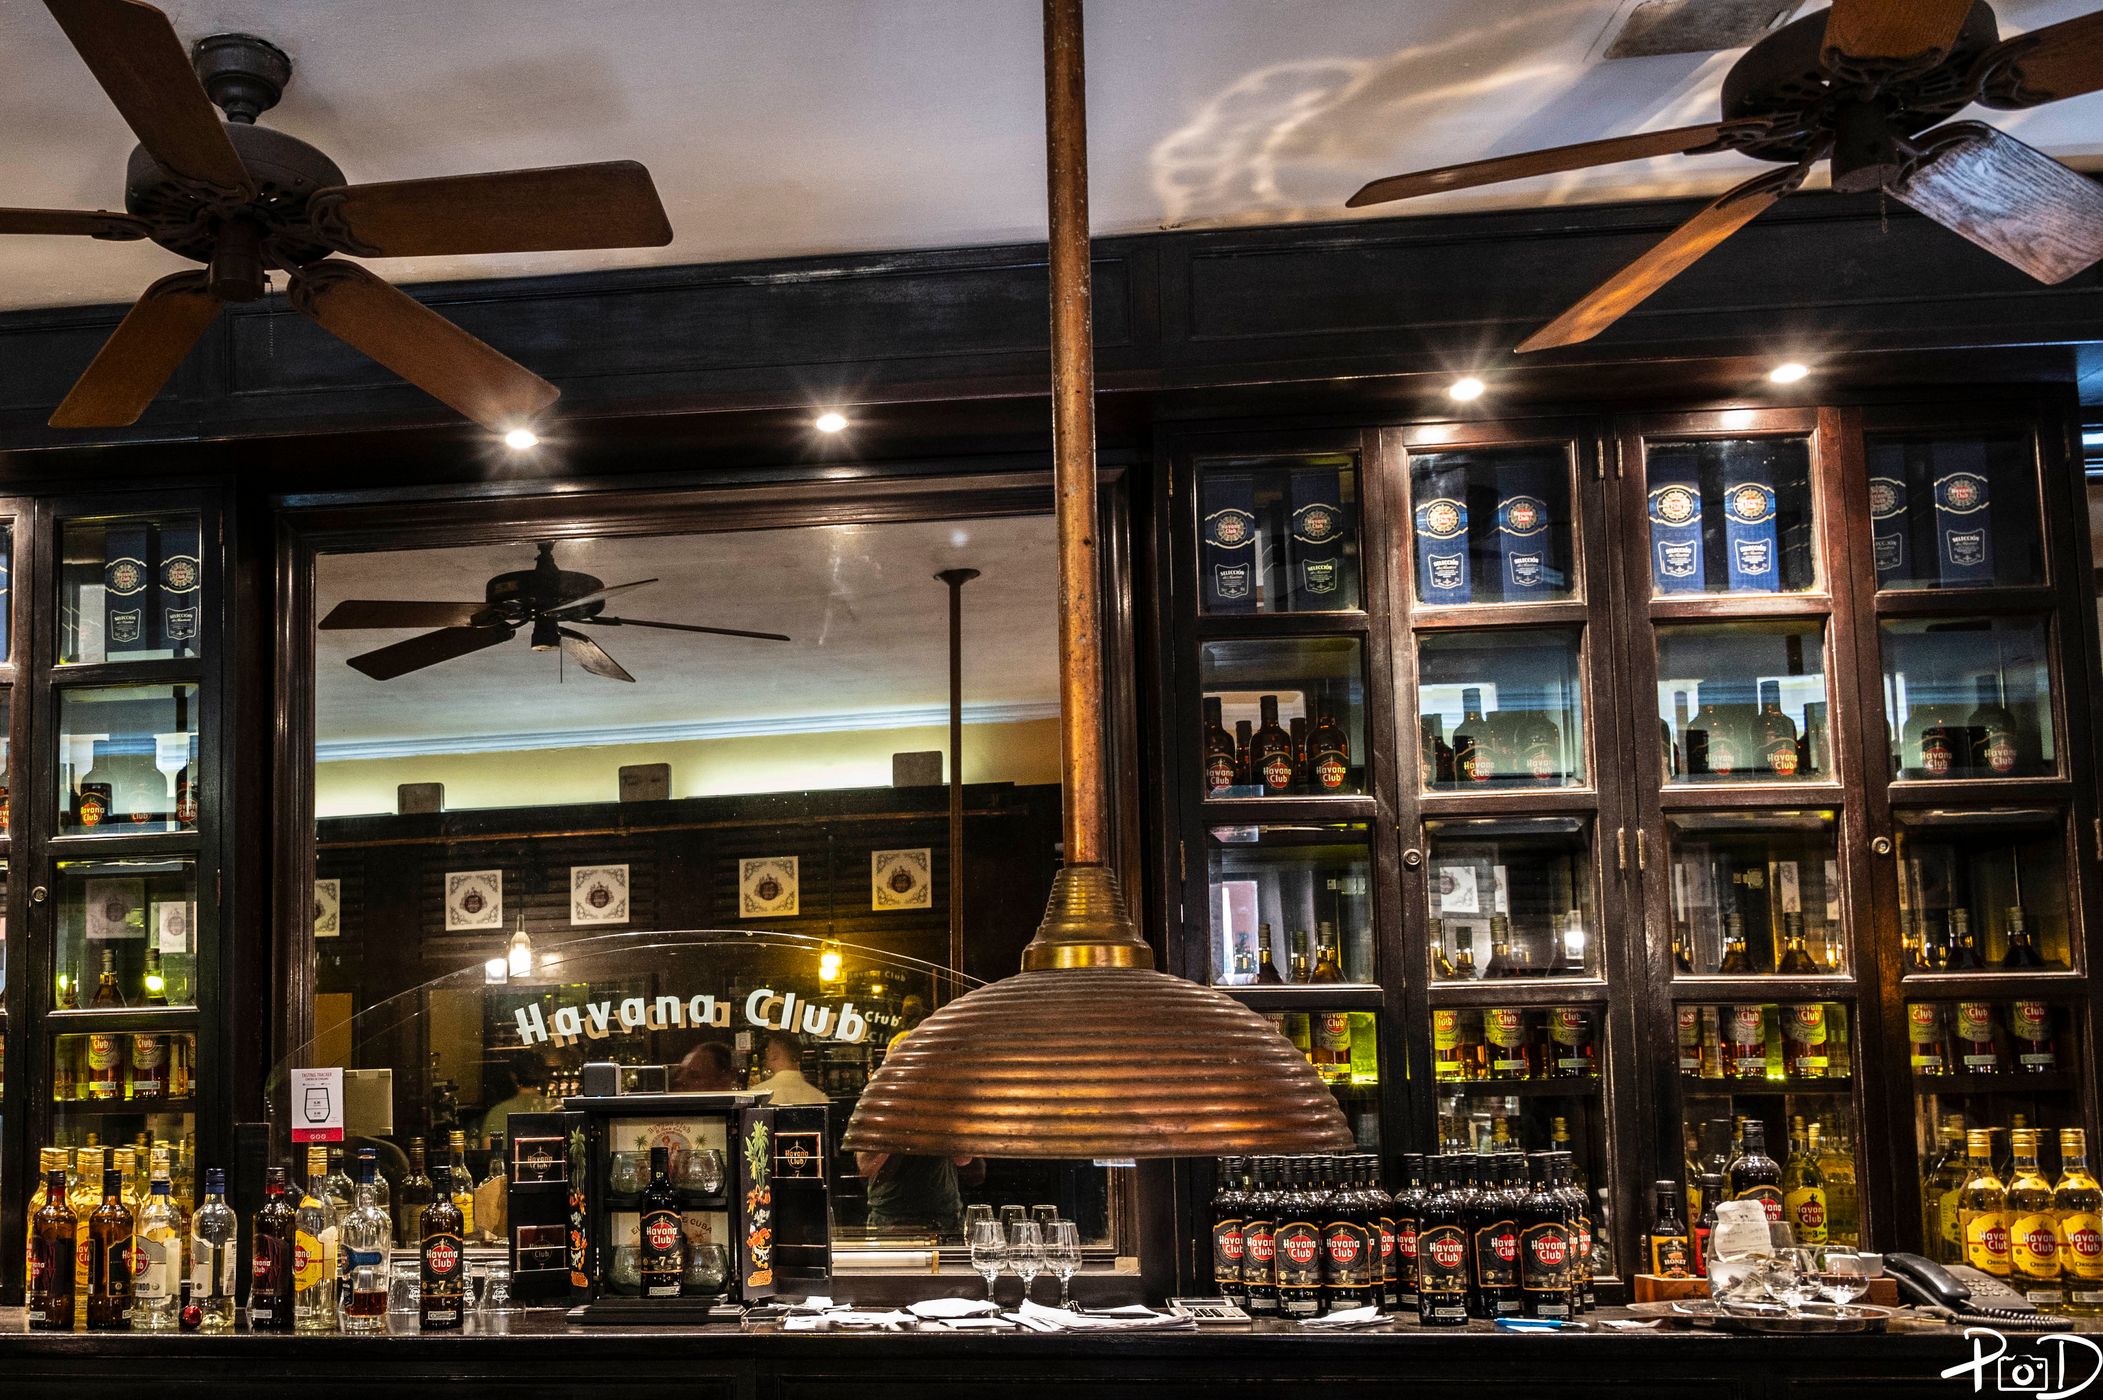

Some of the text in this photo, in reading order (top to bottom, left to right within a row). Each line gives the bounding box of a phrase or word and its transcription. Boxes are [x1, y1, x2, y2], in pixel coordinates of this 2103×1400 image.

[514, 989, 865, 1046] Havana Club
[93, 1040, 109, 1048] Club
[137, 1039, 154, 1048] Club
[784, 1149, 809, 1158] Havana
[790, 1157, 805, 1165] Club
[1763, 1204, 1782, 1213] vana
[1766, 1213, 1777, 1221] ub
[1802, 1214, 1822, 1223] Club
[646, 1226, 679, 1236] Havana
[690, 1218, 712, 1234] CUBA
[652, 1235, 671, 1245] Club
[1219, 1235, 1243, 1245] Hava
[1381, 1235, 1395, 1243] ana
[1397, 1234, 1416, 1243] ava
[1579, 1234, 1591, 1242] ana
[1979, 1231, 2007, 1241] Hava
[2067, 1232, 2103, 1242] Havan
[1246, 1237, 1274, 1247] Havan
[1283, 1239, 1316, 1249] Havana
[1326, 1238, 1360, 1248] Havana
[1491, 1237, 1515, 1248] Hava
[1531, 1240, 1567, 1250] Havana
[2031, 1242, 2054, 1252] Club
[2076, 1242, 2100, 1252] Club
[1252, 1246, 1273, 1256] Club
[1332, 1248, 1353, 1257] Club
[1381, 1244, 1391, 1252] ub
[1429, 1242, 1463, 1253] Havana
[426, 1249, 458, 1259] Havana
[1290, 1248, 1311, 1258] Club
[1437, 1252, 1459, 1262] Club
[1539, 1250, 1561, 1260] Club
[432, 1259, 452, 1268] Club
[658, 1256, 667, 1267] 7
[1232, 1265, 1240, 1276] 7
[1260, 1268, 1268, 1278] 7
[1406, 1264, 1414, 1275] 7
[1299, 1270, 1307, 1281] 7
[1340, 1269, 1348, 1281] 7
[1548, 1272, 1556, 1283] 7
[438, 1280, 446, 1290] 7
[1445, 1275, 1454, 1286] 7
